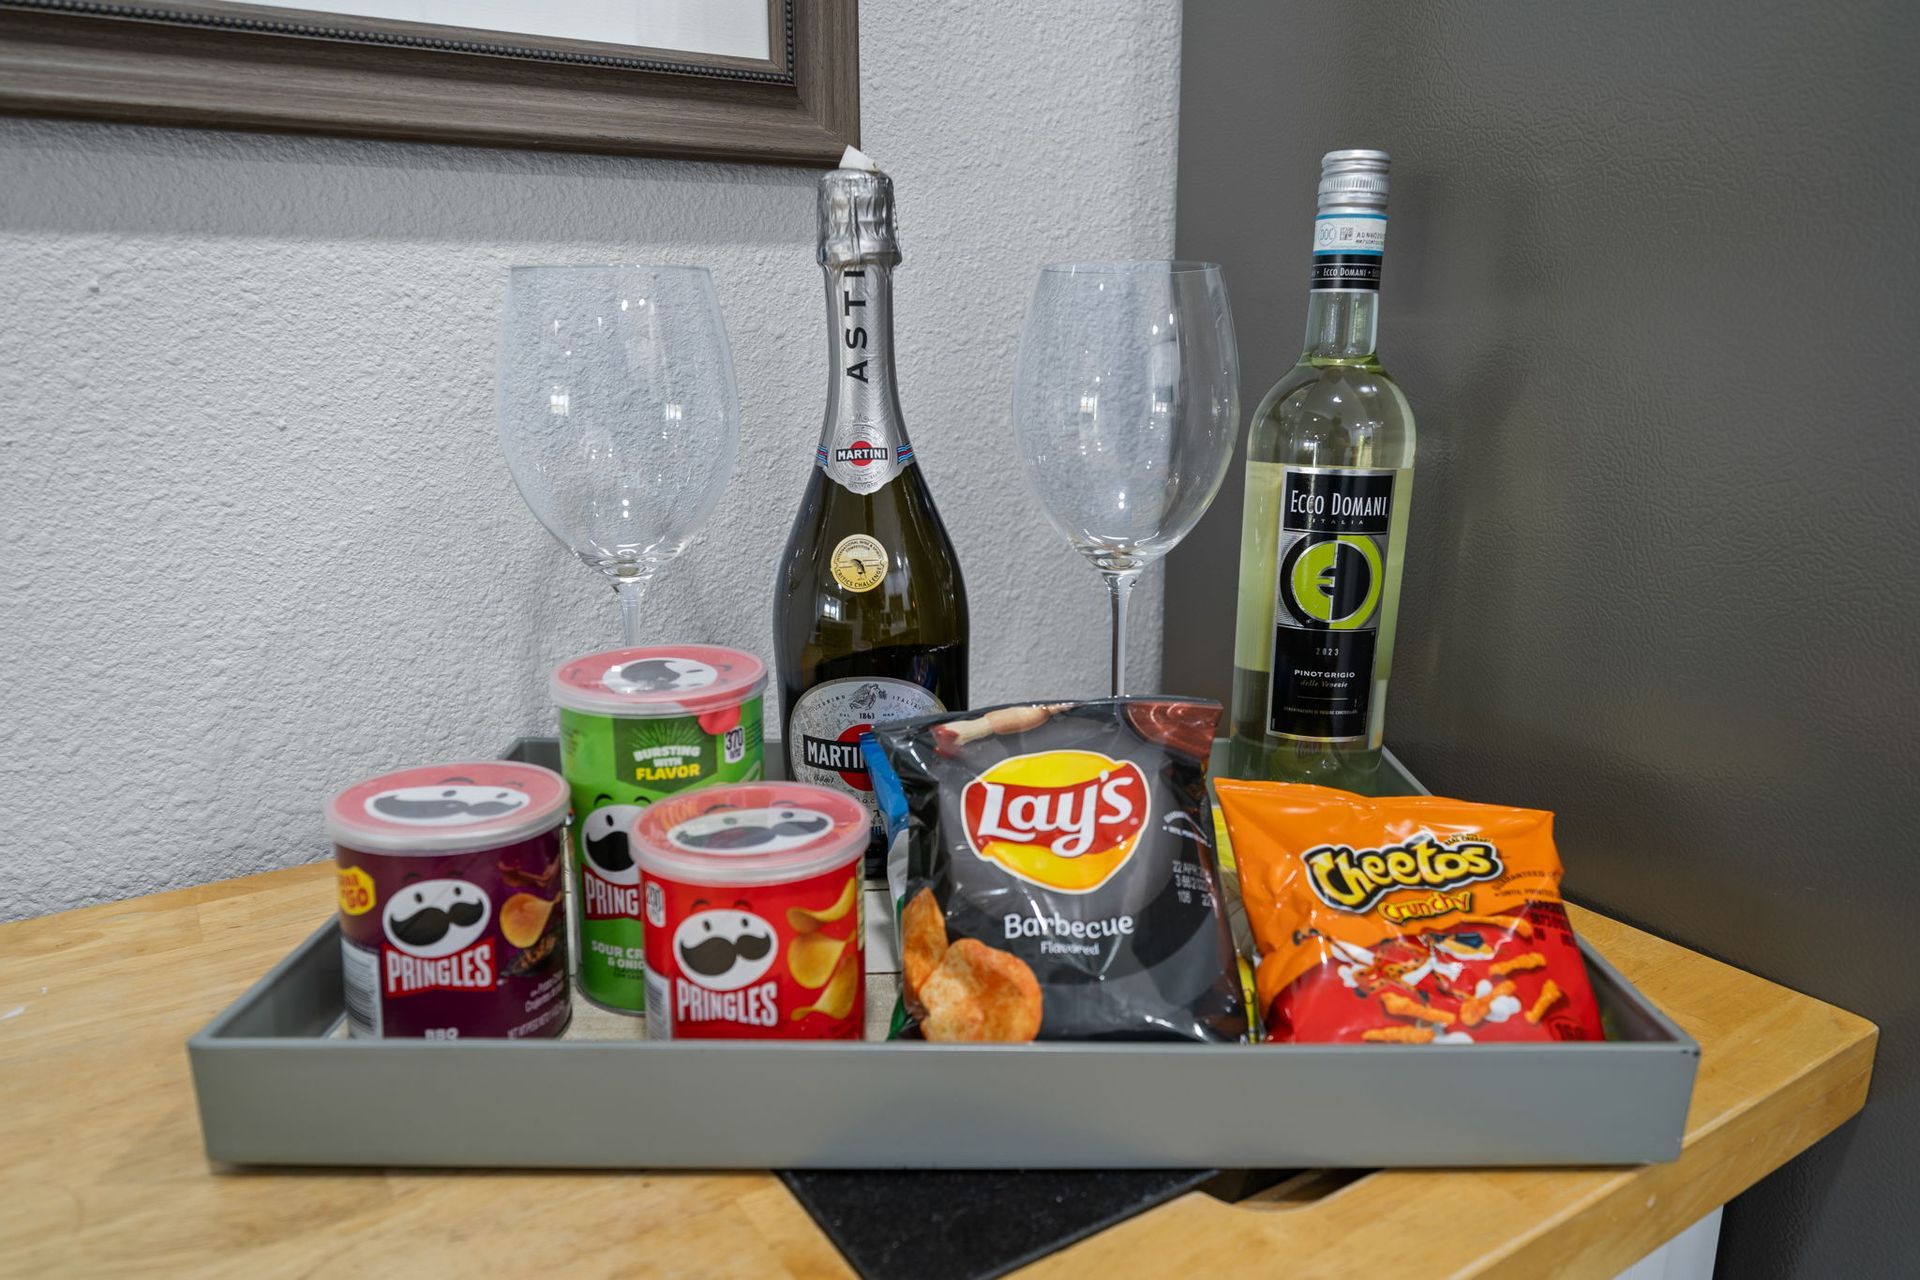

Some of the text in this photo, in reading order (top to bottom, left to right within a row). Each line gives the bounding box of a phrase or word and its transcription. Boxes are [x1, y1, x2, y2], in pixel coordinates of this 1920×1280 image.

[1322, 267, 1338, 277] ECCO
[1340, 267, 1367, 277] DOMANI
[844, 269, 869, 383] ASTI
[837, 448, 886, 461] MARTINI
[1290, 490, 1387, 517] ECCO DOMANI
[1315, 648, 1339, 656] 2023
[1294, 669, 1322, 677] PINOT
[859, 712, 875, 720] 1863
[633, 745, 701, 762] BURSTING
[653, 757, 682, 767] WITH
[635, 763, 701, 781] FLAVOR
[977, 770, 1134, 858] Lay's
[1307, 833, 1498, 909] Cheetos
[1003, 912, 1136, 939] Barbecue
[591, 940, 623, 958] SOUR
[386, 944, 491, 994] PRINGLES
[676, 977, 778, 1027] PRINGLES
